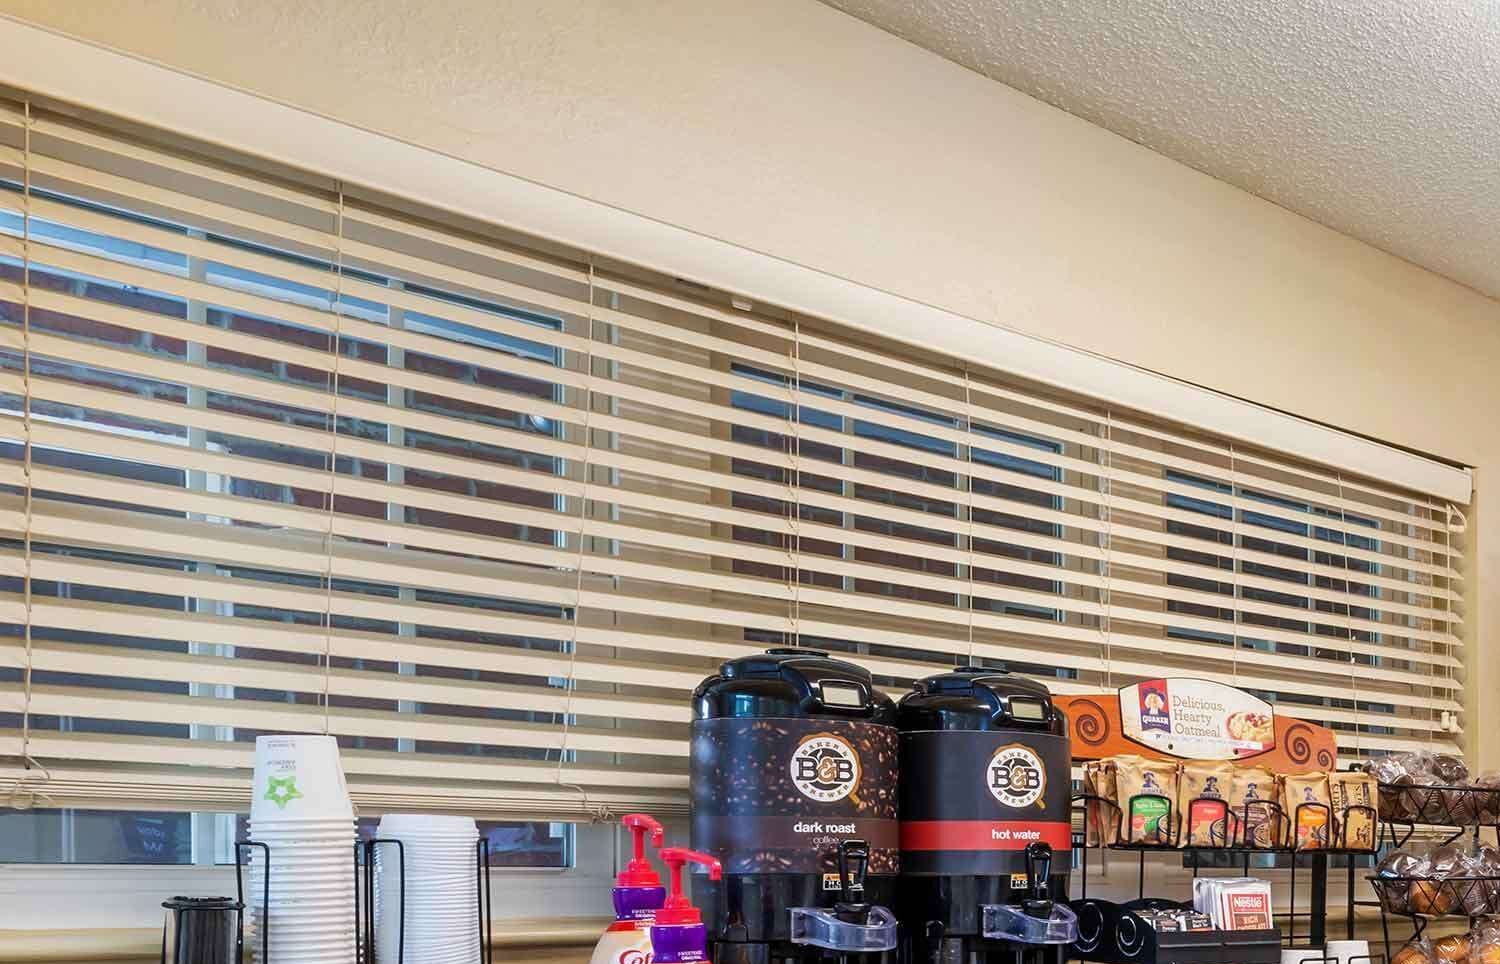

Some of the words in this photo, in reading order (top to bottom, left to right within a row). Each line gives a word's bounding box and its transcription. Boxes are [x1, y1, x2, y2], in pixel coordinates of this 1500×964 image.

[1172, 695, 1226, 713] Delicious,
[1142, 716, 1169, 726] QUAKER
[1174, 709, 1212, 726] Hearty
[1174, 724, 1222, 738] Oatmeal
[795, 756, 854, 784] B&B
[991, 766, 1041, 790] B&B
[793, 821, 823, 834] dark
[825, 822, 857, 834] roast
[991, 829, 1011, 840] hot
[1013, 830, 1041, 840] water
